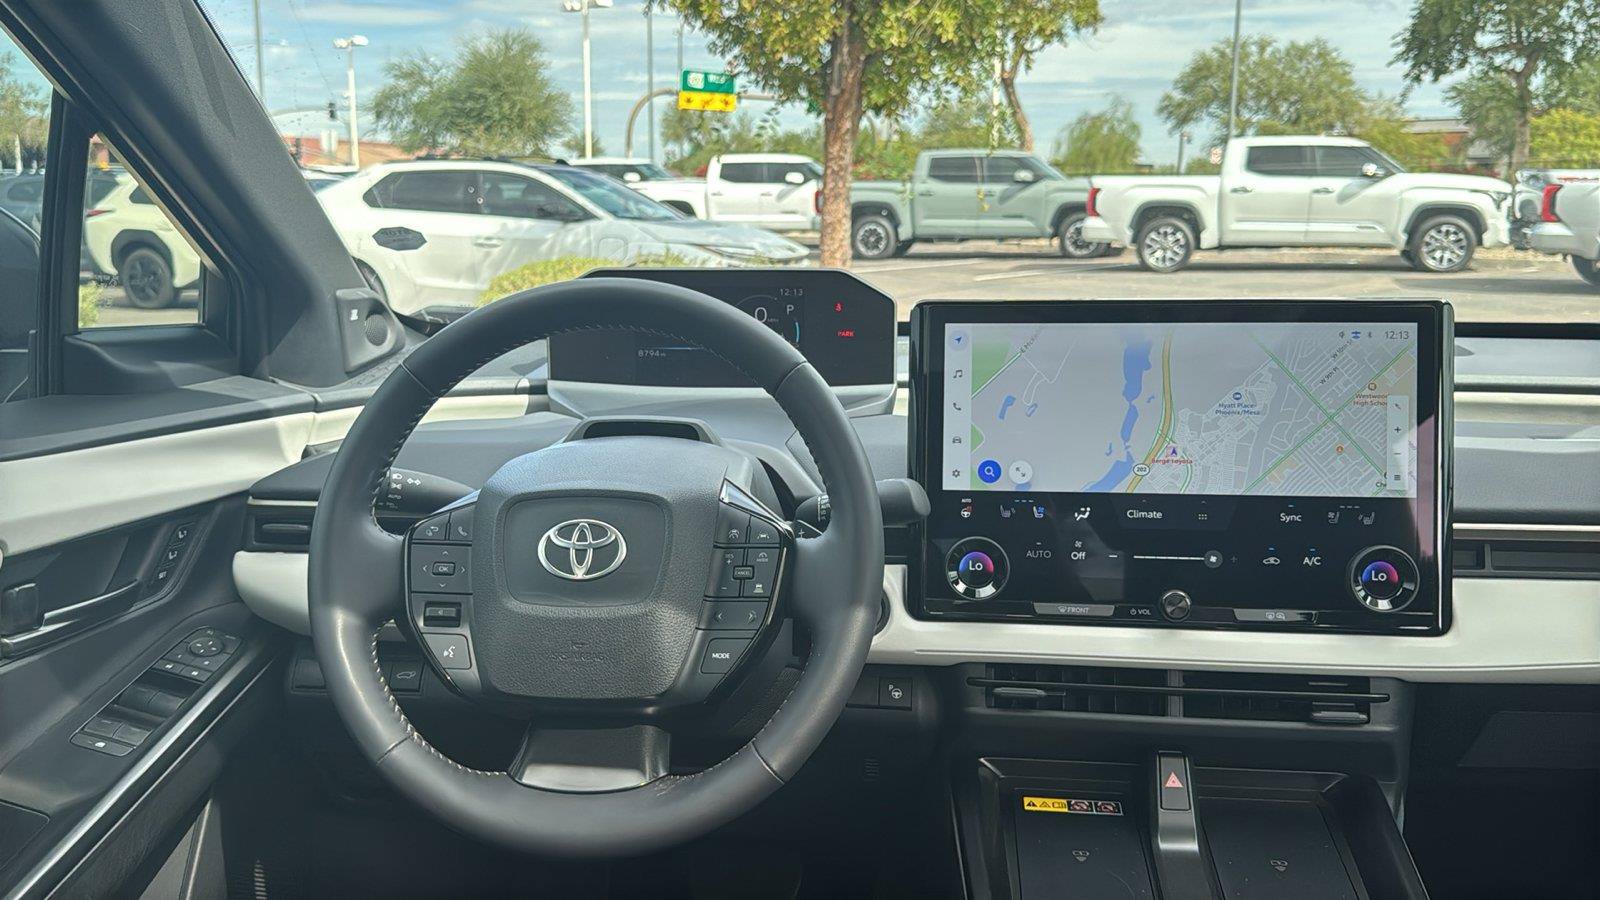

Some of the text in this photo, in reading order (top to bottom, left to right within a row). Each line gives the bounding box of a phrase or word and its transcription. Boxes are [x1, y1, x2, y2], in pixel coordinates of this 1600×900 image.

[780, 288, 803, 296] 12:13
[786, 304, 794, 315] P
[755, 307, 768, 323] 0
[1384, 330, 1410, 340] 12:13
[638, 349, 660, 358] 8794
[1126, 509, 1163, 519] Climate
[1280, 512, 1302, 523] Sync
[1026, 550, 1051, 559] AUTO
[1070, 551, 1086, 560] Off
[969, 560, 983, 571] Lo
[1302, 556, 1322, 566] A/C
[1371, 570, 1387, 581] Lo
